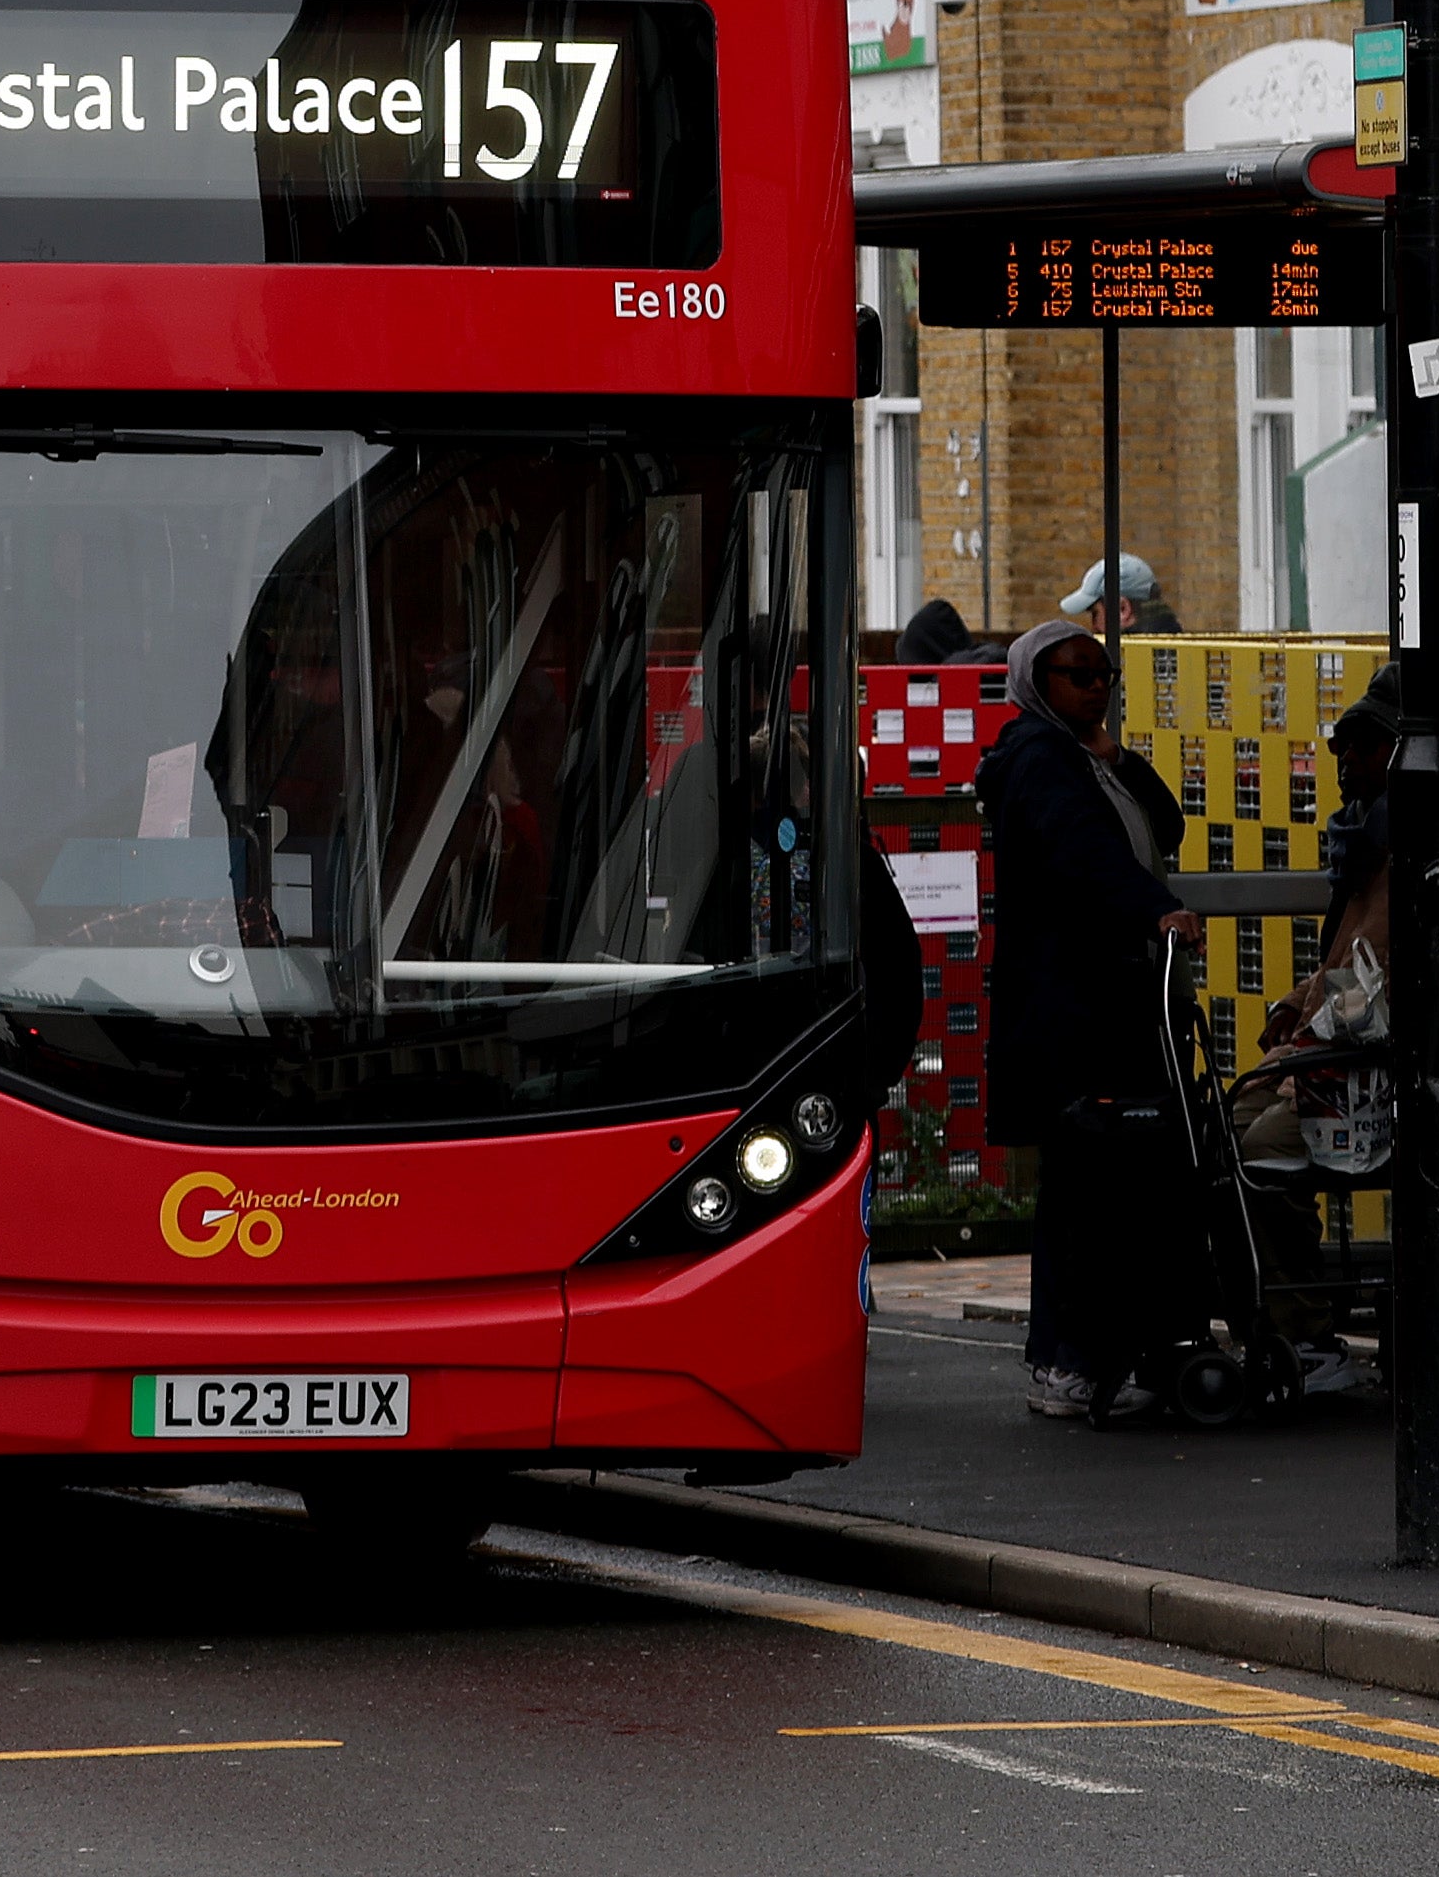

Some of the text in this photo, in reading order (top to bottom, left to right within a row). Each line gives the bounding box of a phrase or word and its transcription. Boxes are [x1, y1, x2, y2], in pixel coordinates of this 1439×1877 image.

[175, 57, 422, 135] Palace
[441, 38, 619, 181] 157
[1361, 118, 1399, 135] No stopping
[1360, 140, 1401, 158] except buses
[1009, 240, 1318, 260] 1 157 Crystal Palace due
[1007, 263, 1318, 282] 5 410 Crystal Palace 14min
[1007, 282, 1318, 298] 6 75 Lewisham Stn 17min
[613, 281, 726, 320] Ee180
[1007, 301, 1318, 320] 7 157 Crystal Palace 26min
[229, 1186, 400, 1209] Ahead-London
[160, 1170, 284, 1259] Go
[165, 1381, 399, 1427] LG23 EUX
